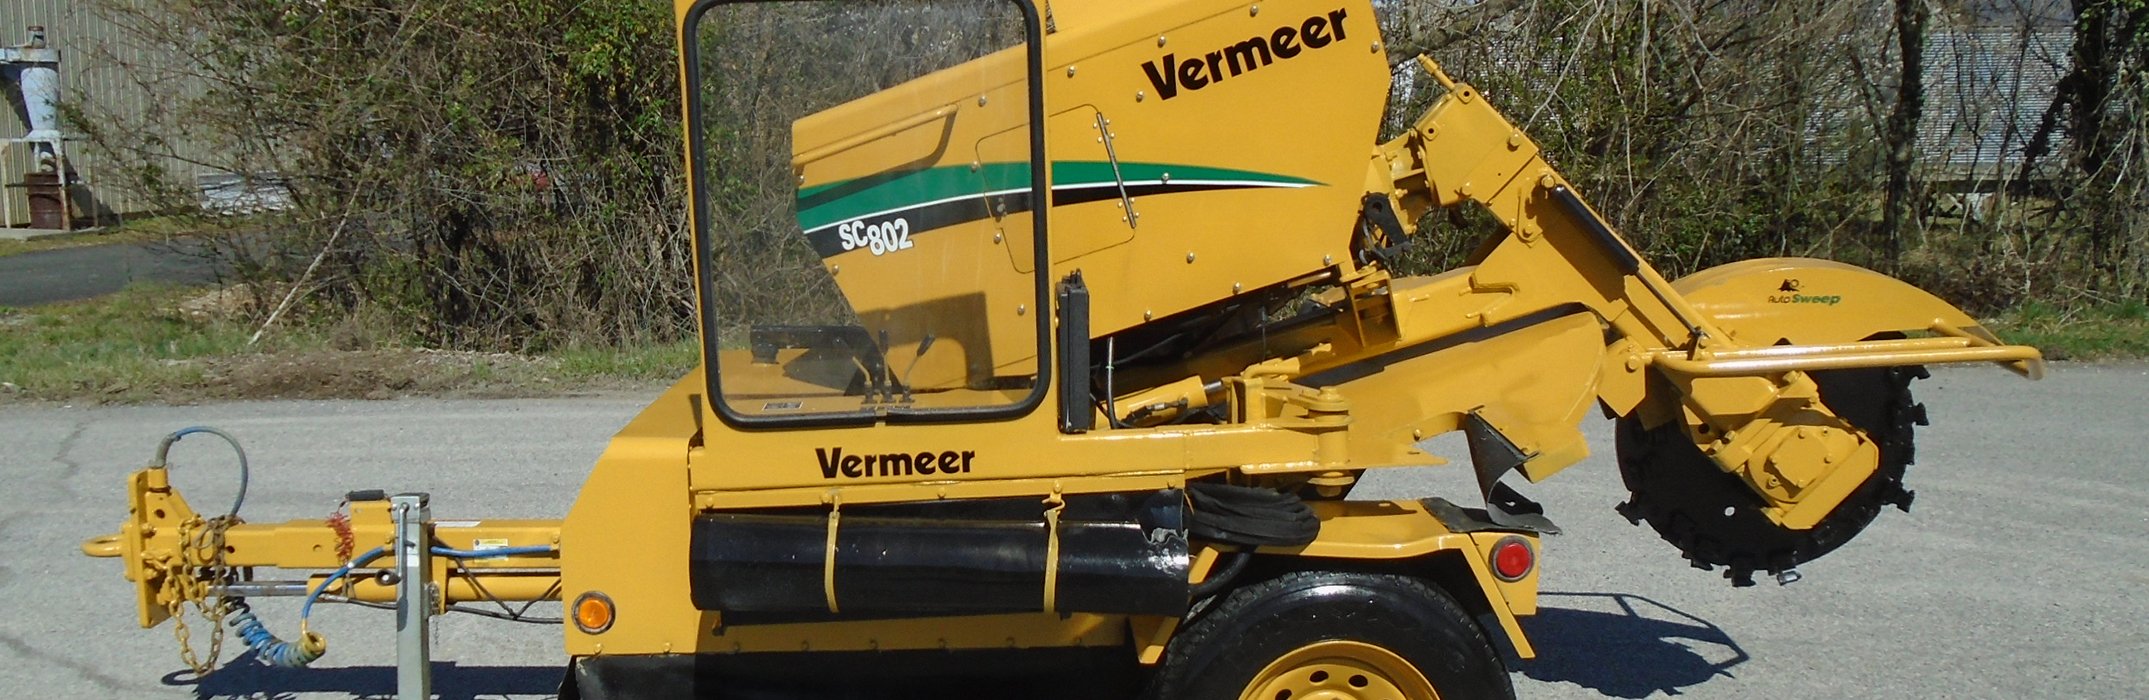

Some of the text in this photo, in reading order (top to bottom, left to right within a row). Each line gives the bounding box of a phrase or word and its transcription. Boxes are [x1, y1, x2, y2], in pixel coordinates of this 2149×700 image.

[1141, 8, 1347, 101] Vermeer
[838, 218, 913, 256] SC802
[815, 447, 976, 479] Vermeer
